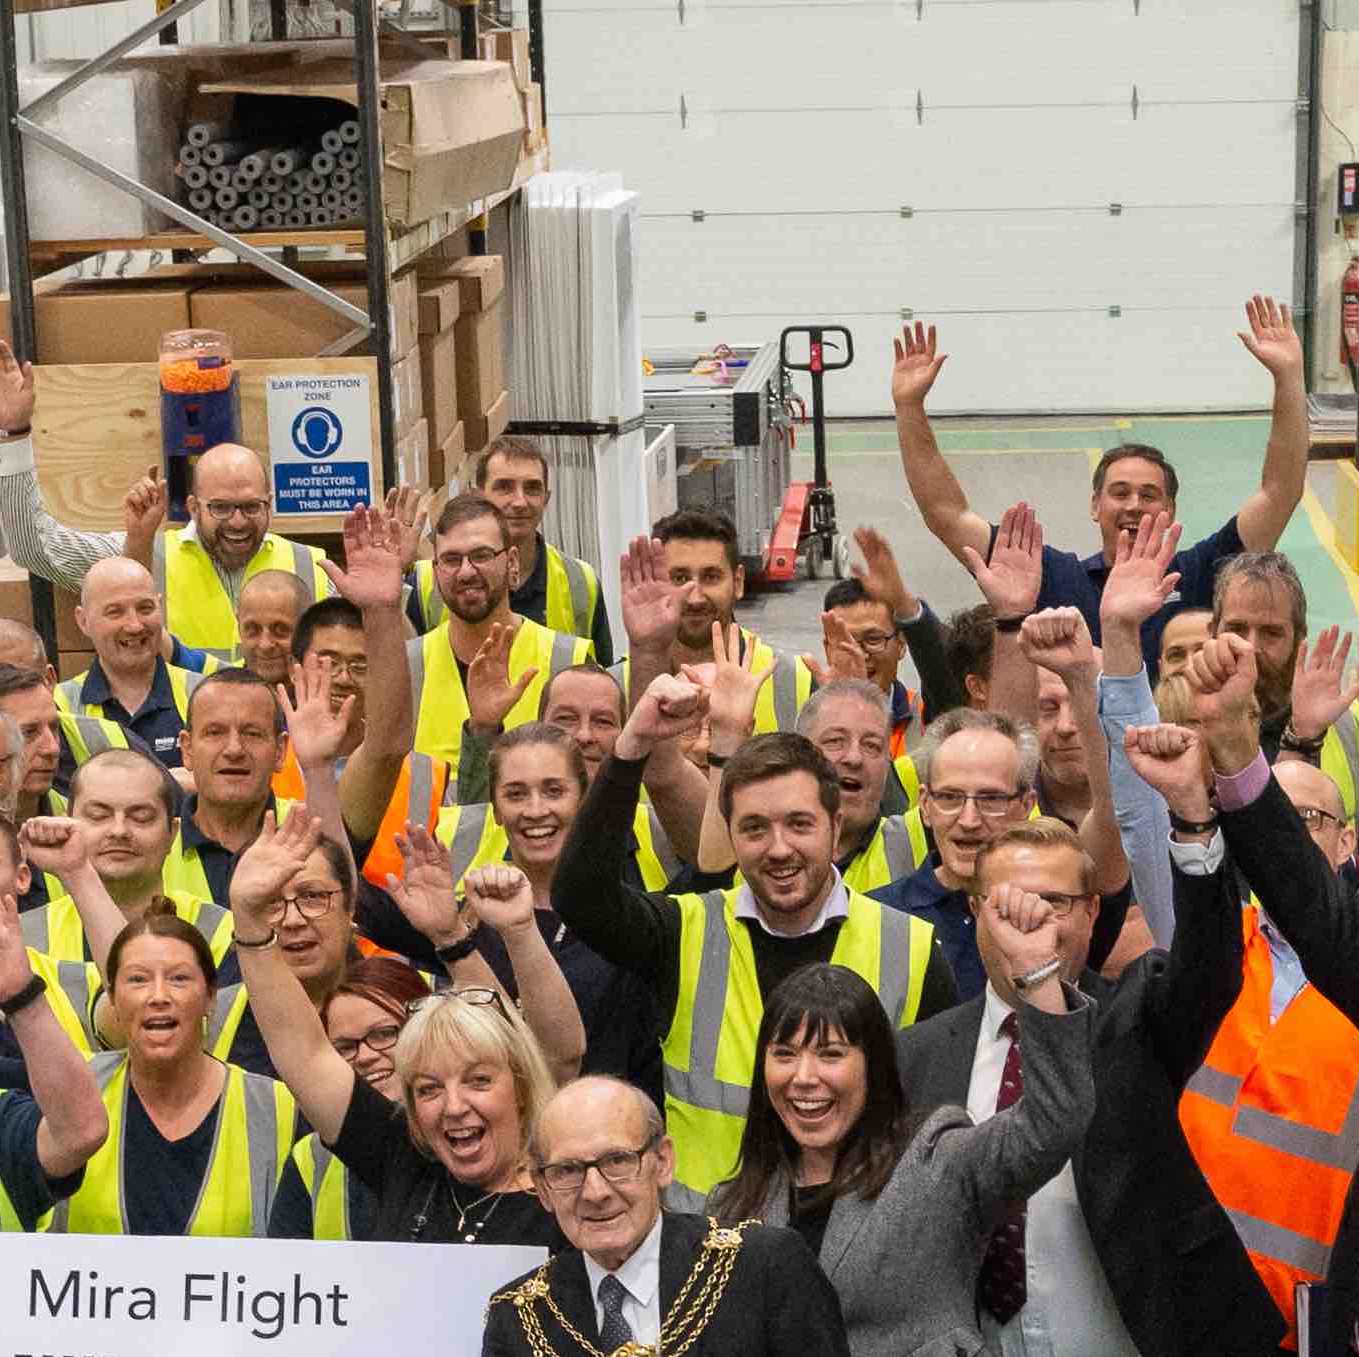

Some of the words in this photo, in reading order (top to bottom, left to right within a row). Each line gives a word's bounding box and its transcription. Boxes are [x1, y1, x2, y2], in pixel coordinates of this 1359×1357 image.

[272, 380, 292, 390] EAR
[295, 379, 361, 390] PROTECTION
[304, 392, 332, 401] ZONE
[311, 465, 333, 475] EAR
[289, 476, 356, 487] PROTECTORS
[279, 489, 306, 498] MUST
[308, 488, 322, 498] BE
[324, 488, 355, 498] WORN
[357, 487, 368, 497] IN
[298, 500, 321, 510] THIS
[322, 500, 350, 510] AREA
[29, 1268, 156, 1321] Mira
[183, 1271, 349, 1340] Flight
